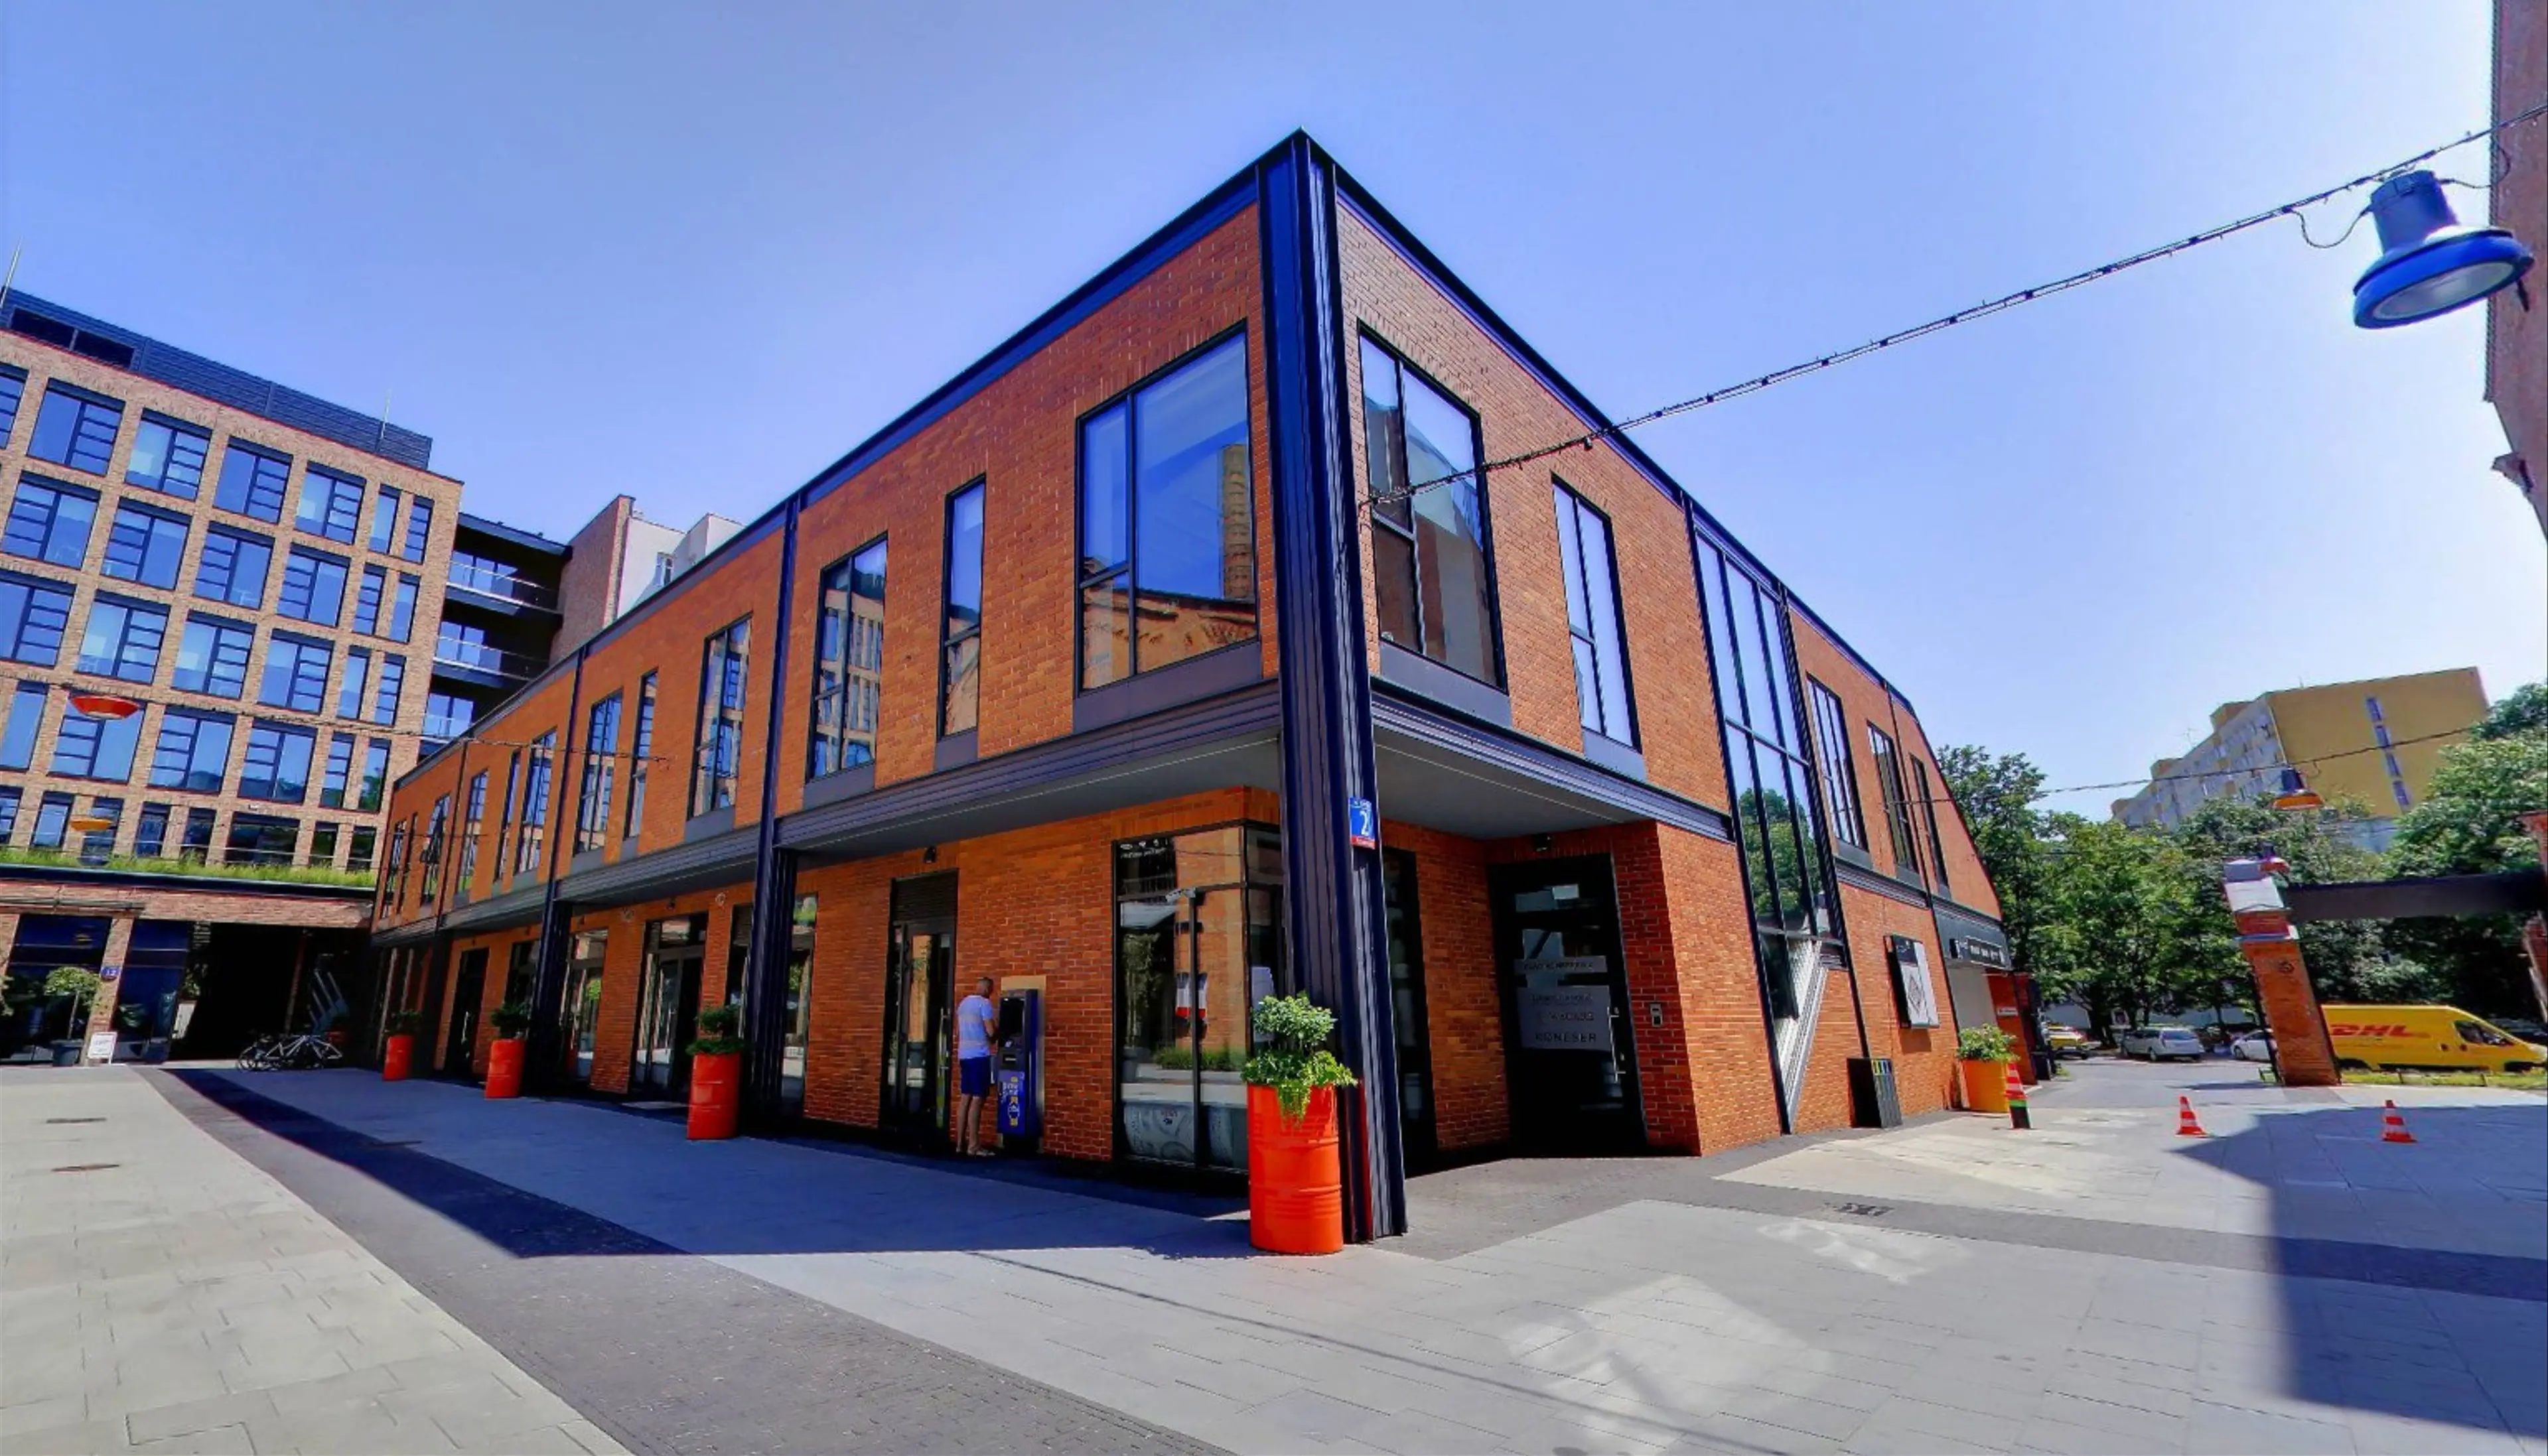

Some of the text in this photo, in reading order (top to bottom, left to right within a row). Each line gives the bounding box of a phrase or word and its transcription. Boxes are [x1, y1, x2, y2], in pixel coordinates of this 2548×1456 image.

[1359, 810, 1370, 836] 2
[1535, 1031, 1597, 1043] KONESER
[2330, 1024, 2414, 1038] DHL
